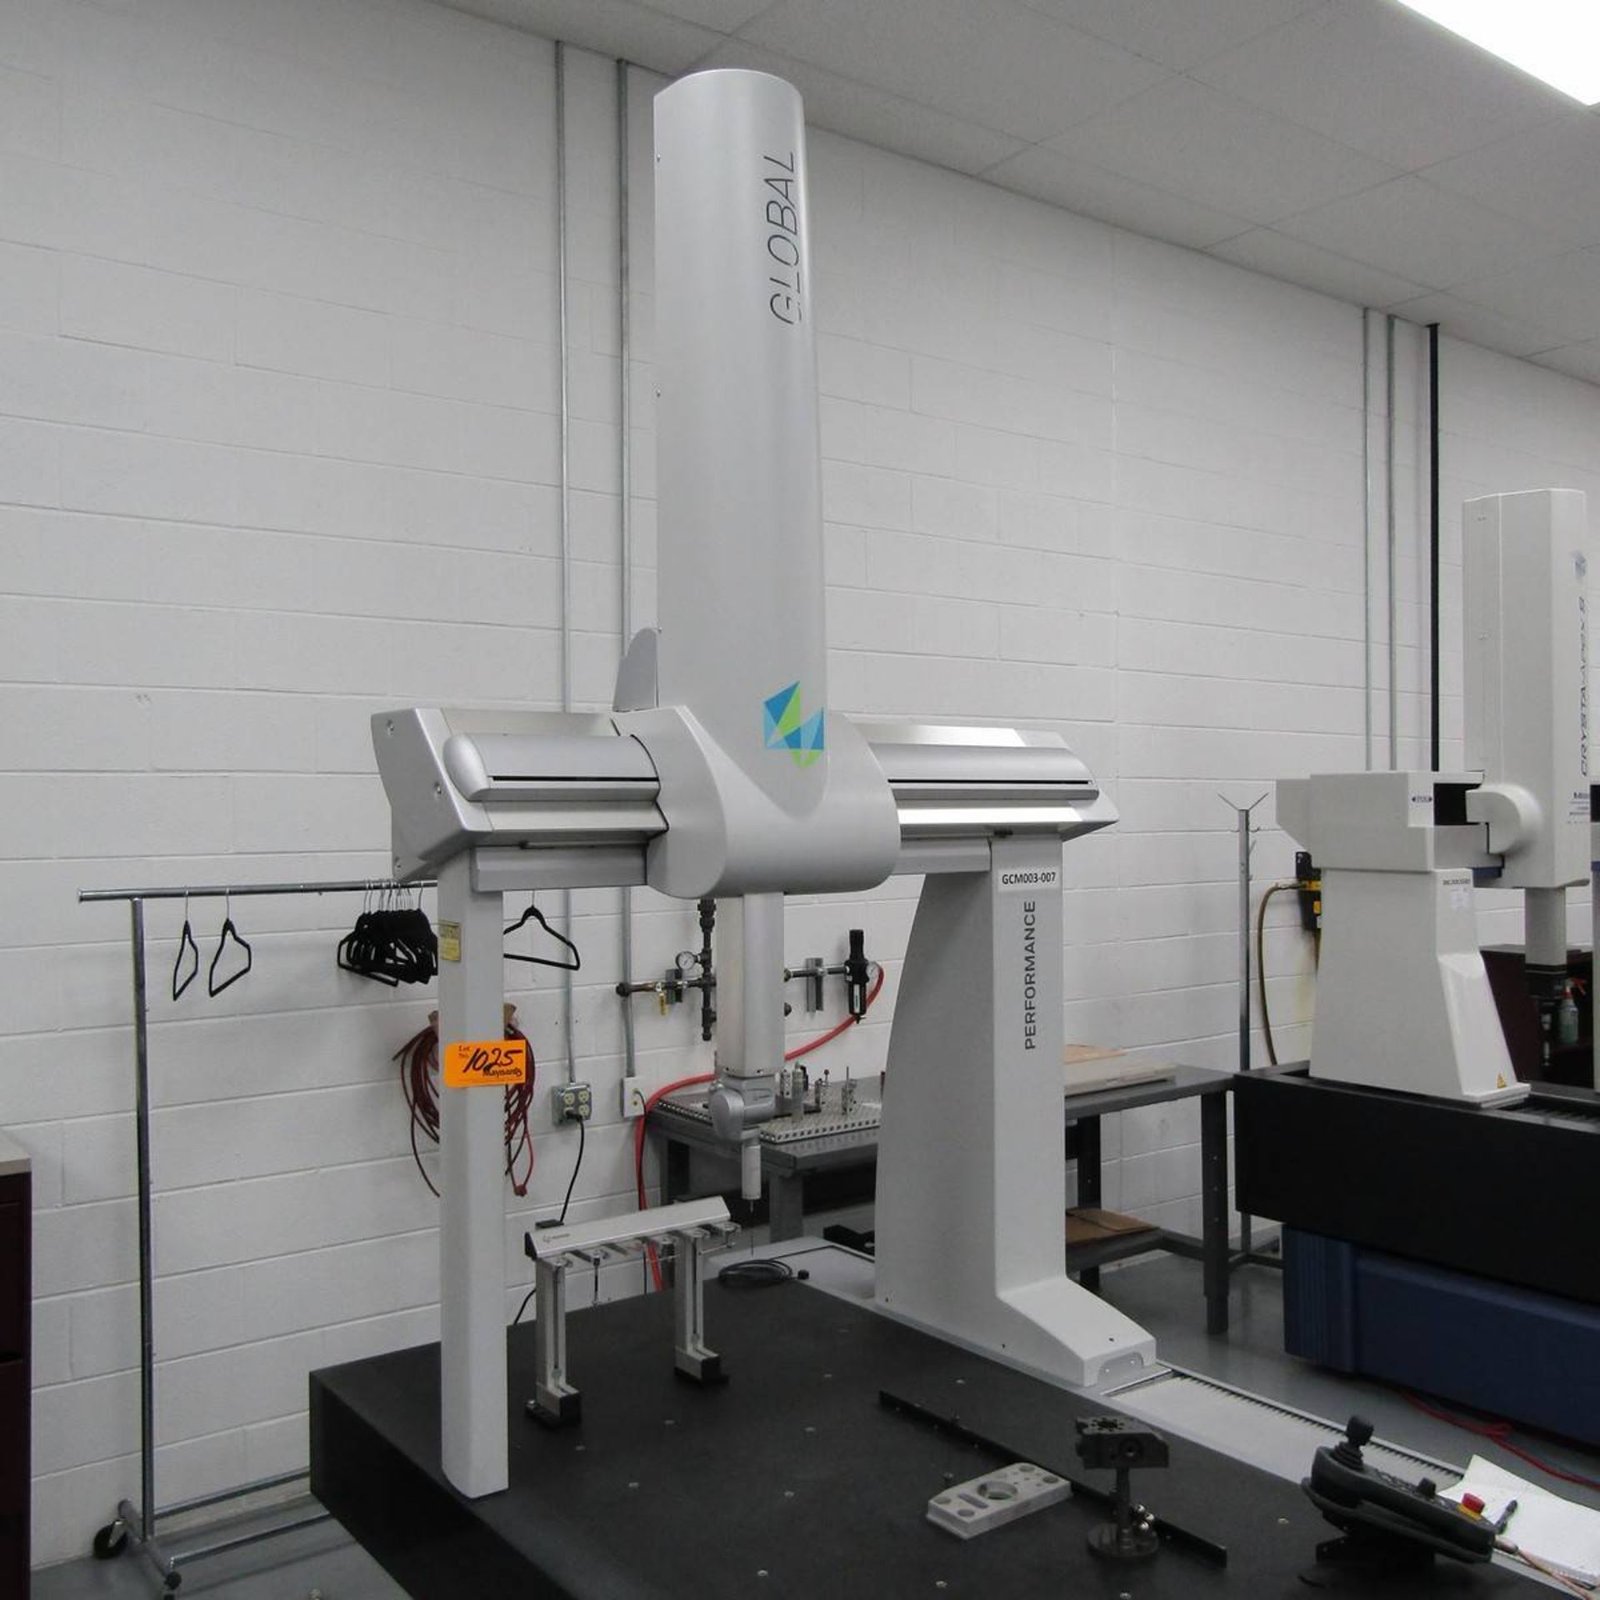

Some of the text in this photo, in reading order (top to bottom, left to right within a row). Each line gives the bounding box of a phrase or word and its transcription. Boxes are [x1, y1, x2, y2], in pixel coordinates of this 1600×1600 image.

[763, 151, 802, 325] GLOBAL
[1001, 871, 1057, 885] GCM003-007
[1023, 900, 1037, 1051] PERFORMANCE
[462, 1047, 524, 1073] 1025
